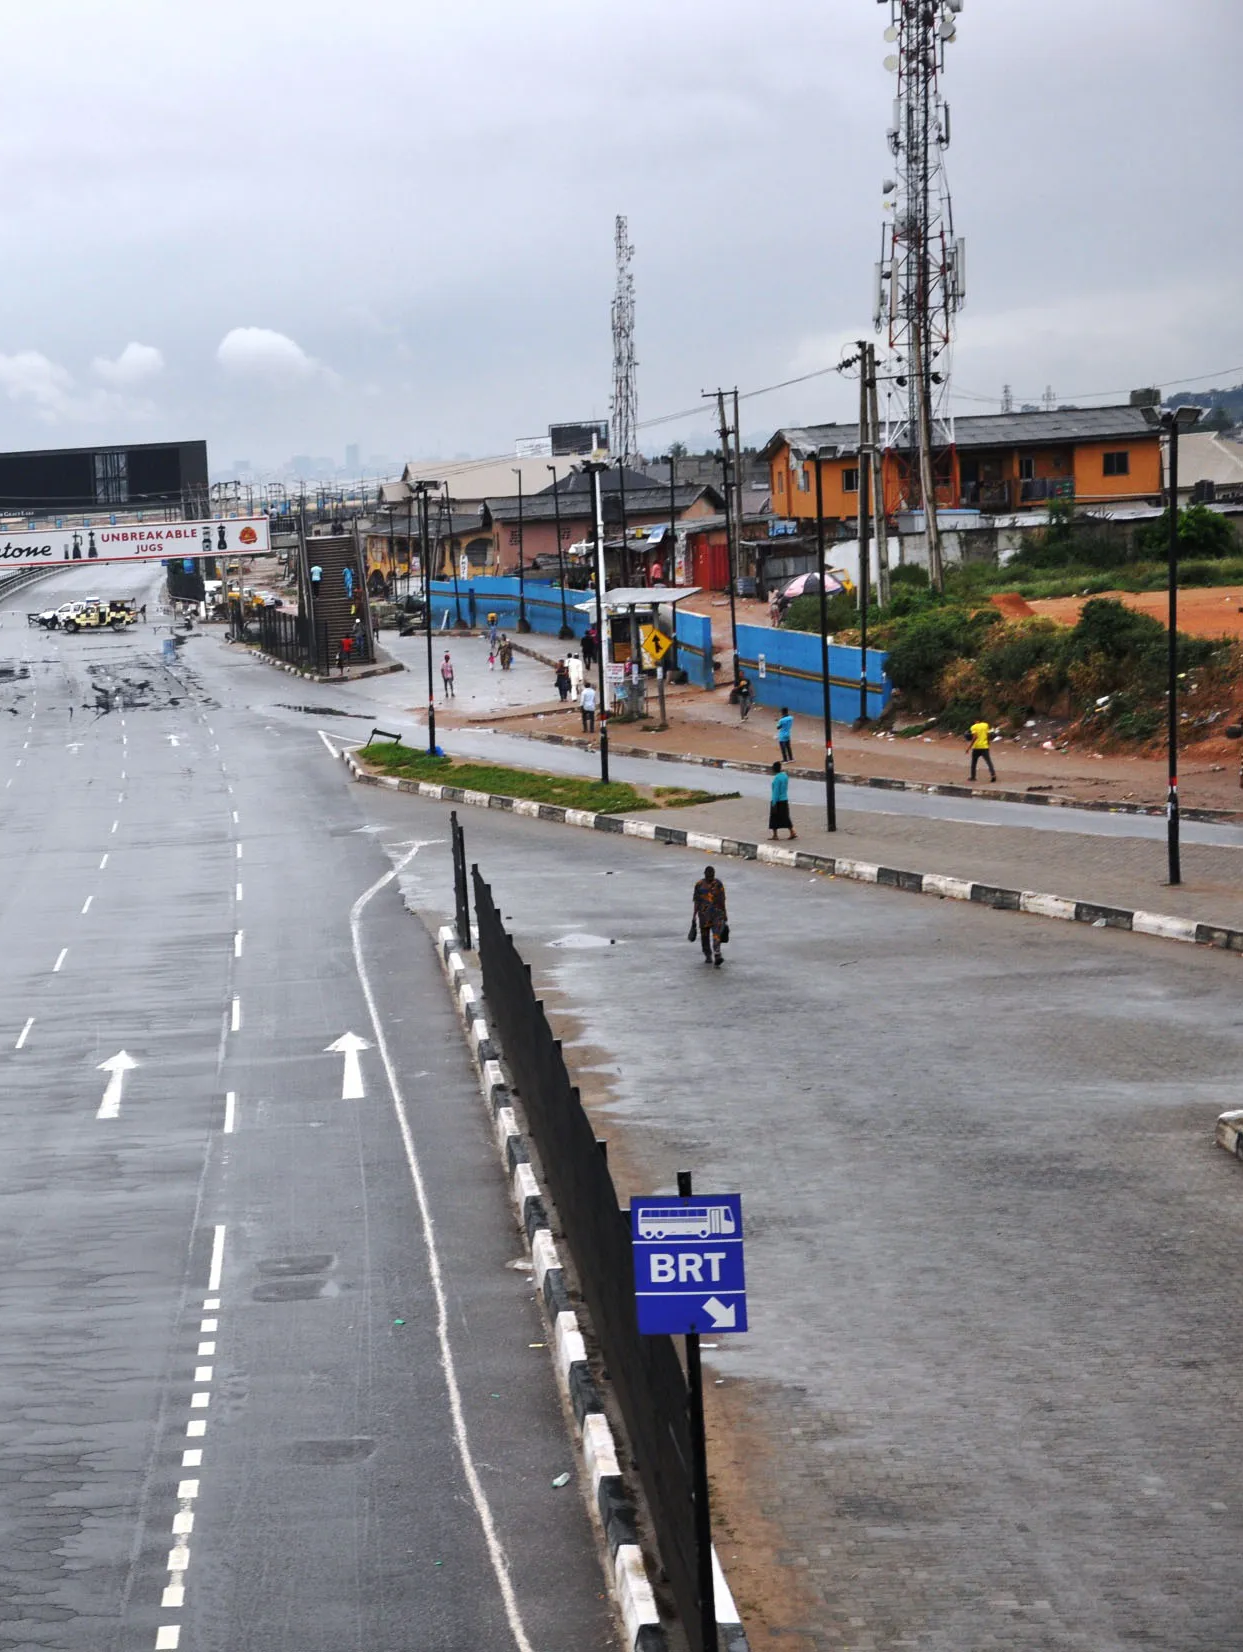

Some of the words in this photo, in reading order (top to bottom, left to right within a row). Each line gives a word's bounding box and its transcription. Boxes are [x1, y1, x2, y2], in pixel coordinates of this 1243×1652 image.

[101, 528, 198, 543] UNBREAKABLE
[135, 543, 164, 555] JUGS
[649, 1252, 726, 1283] BRT
